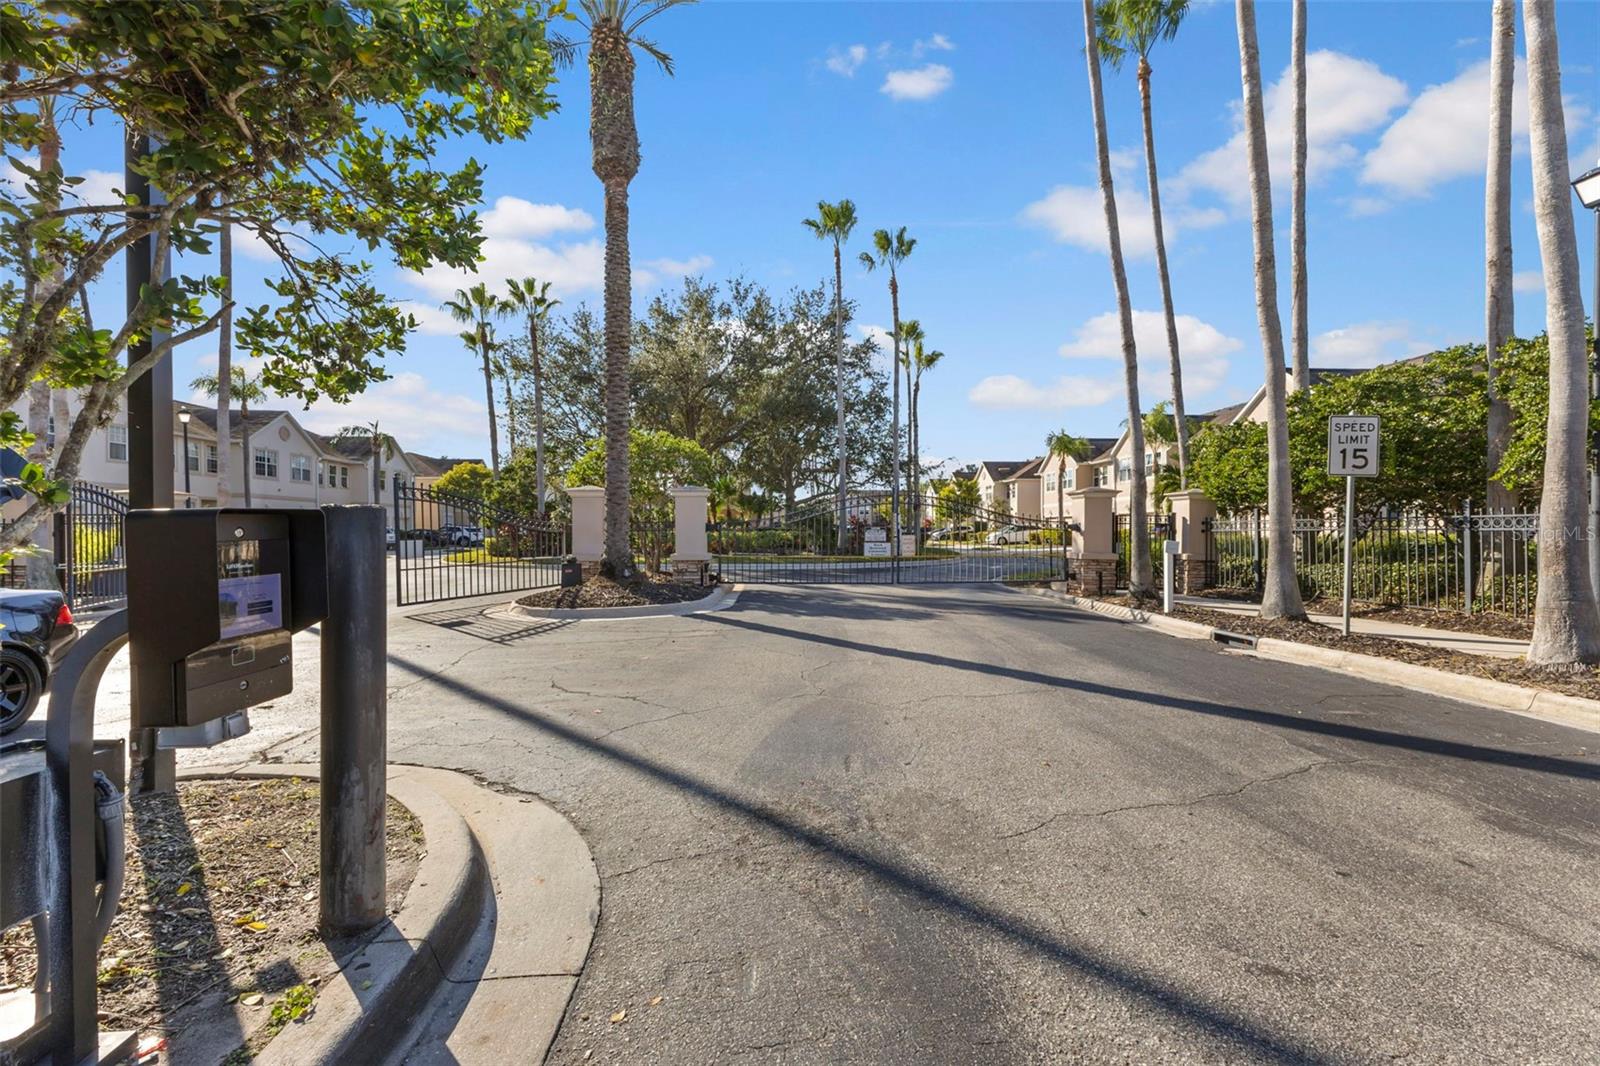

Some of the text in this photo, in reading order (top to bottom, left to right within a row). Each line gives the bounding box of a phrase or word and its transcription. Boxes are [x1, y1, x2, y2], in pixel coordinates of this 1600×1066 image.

[1334, 422, 1376, 433] SPEED
[1338, 434, 1370, 445] LIMIT
[1339, 448, 1369, 470] 15
